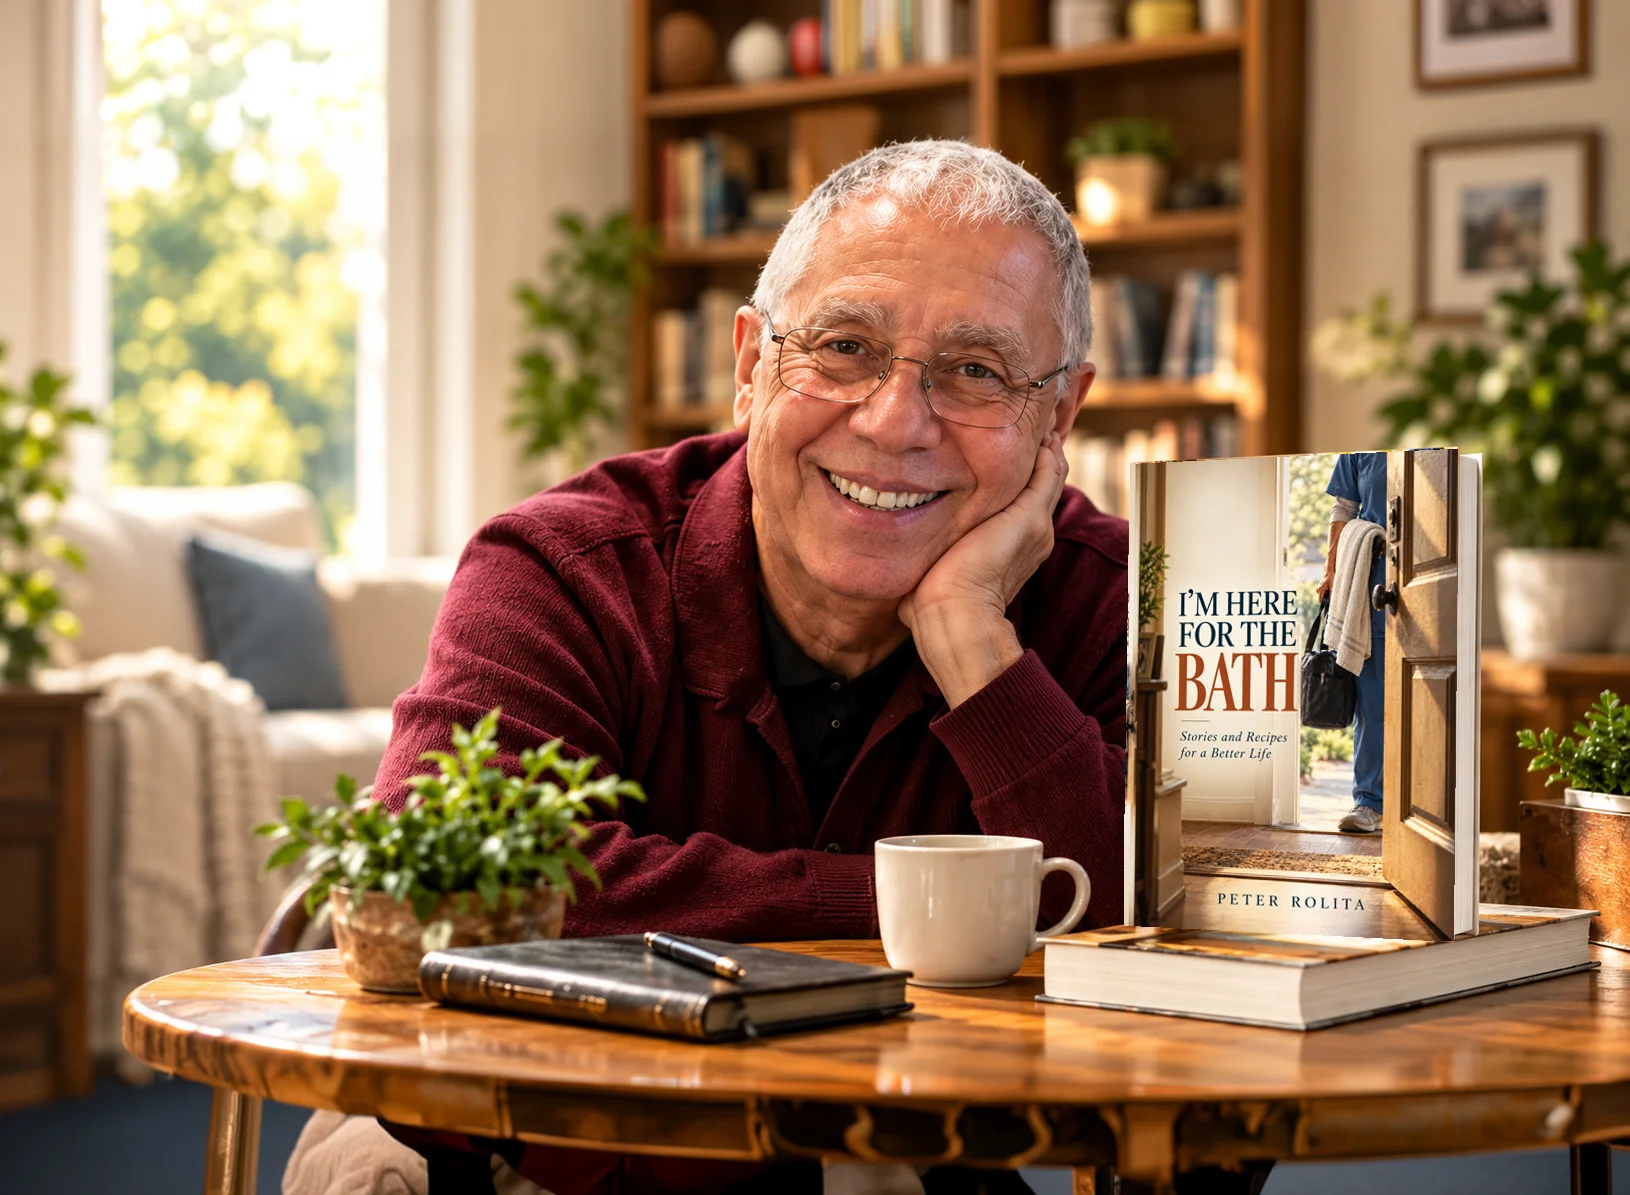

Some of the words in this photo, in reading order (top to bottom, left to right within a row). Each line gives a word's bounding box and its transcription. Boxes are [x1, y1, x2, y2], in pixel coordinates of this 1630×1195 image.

[1226, 590, 1298, 616] HERE
[1179, 621, 1234, 648] FOR
[1240, 621, 1297, 647] THE
[1174, 652, 1299, 712] BATH
[1180, 731, 1218, 743] Stories
[1221, 731, 1243, 743] and
[1246, 731, 1288, 745] Recipes
[1178, 747, 1196, 761] for
[1200, 751, 1207, 759] a
[1211, 748, 1246, 760] Better
[1249, 748, 1272, 761] Life
[1218, 893, 1279, 907] PETER
[1291, 896, 1365, 911] ROLITA
